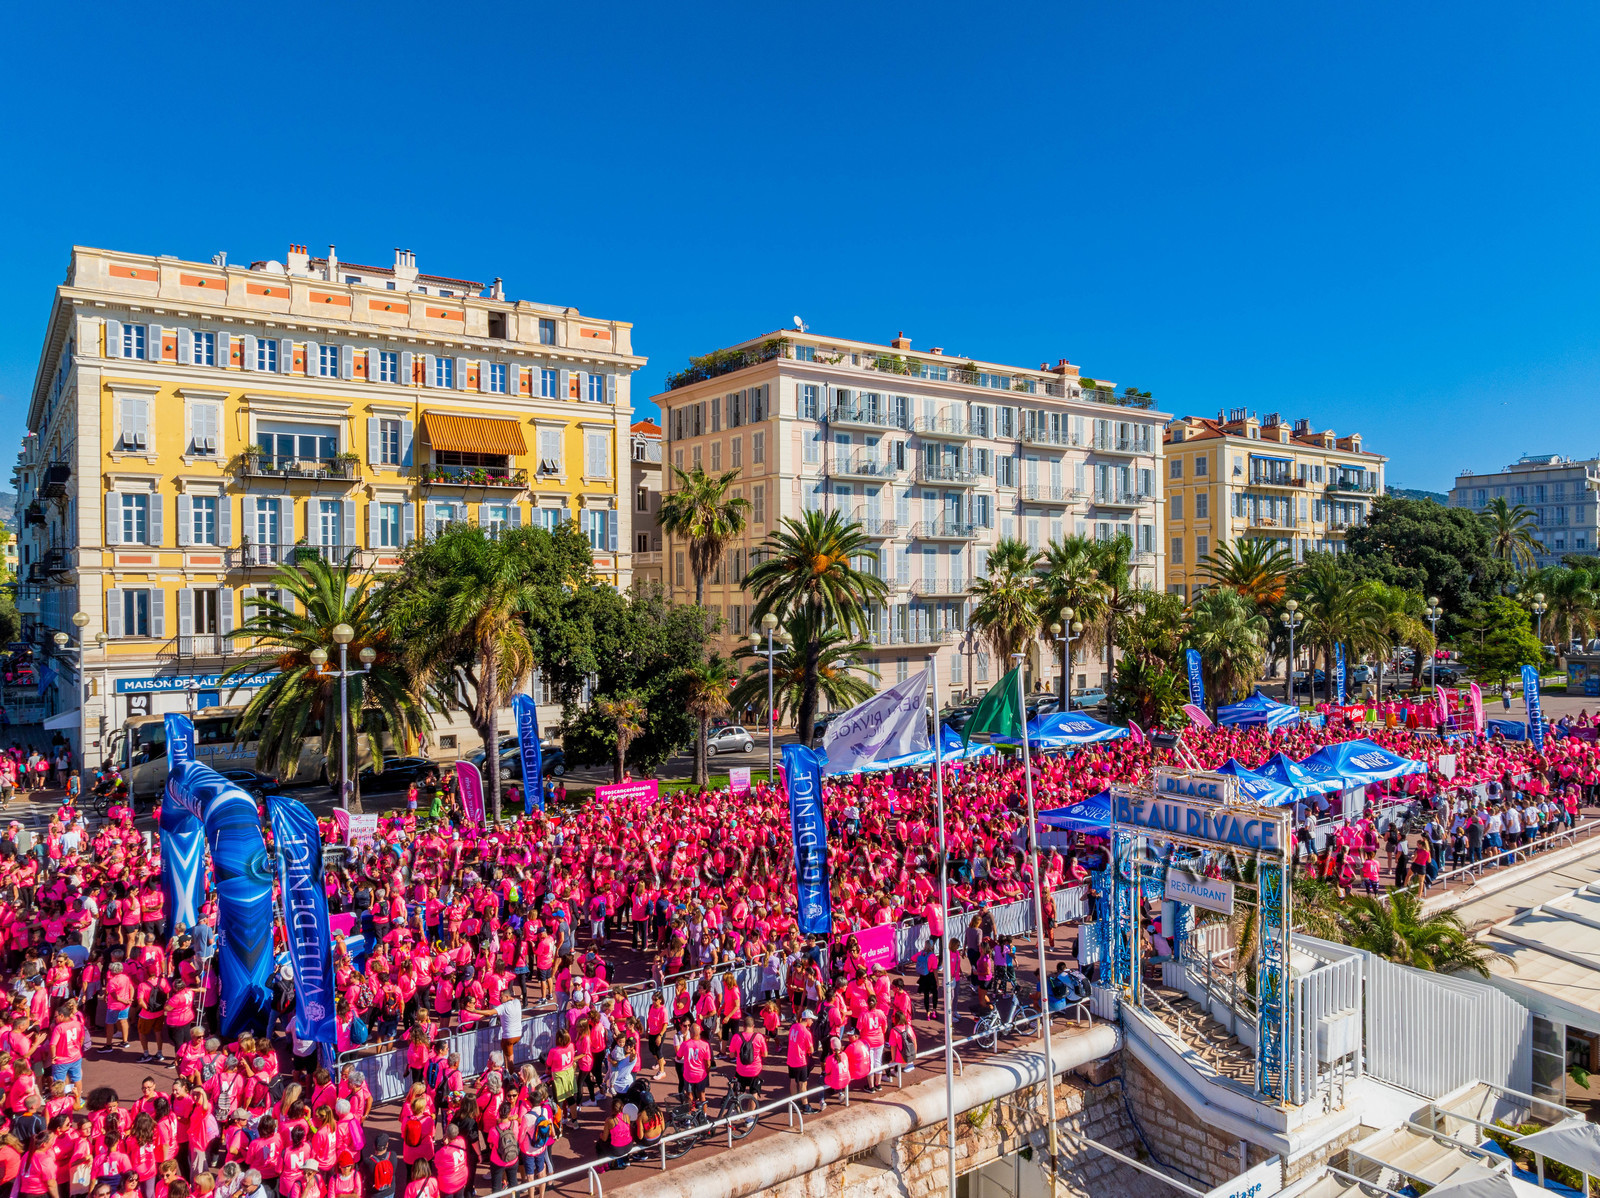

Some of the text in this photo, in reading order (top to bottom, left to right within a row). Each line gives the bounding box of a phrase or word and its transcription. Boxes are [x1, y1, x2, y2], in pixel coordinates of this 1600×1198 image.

[125, 678, 172, 690] MAISON
[1527, 678, 1539, 703] NICE
[520, 710, 538, 792] VILLE DE NICE
[1365, 756, 1394, 768] NICE
[601, 785, 651, 796] #soscancerdusein
[1081, 810, 1108, 820] NICE
[1117, 796, 1275, 847] BEAU RIVAGE
[794, 770, 822, 899] VILLE DE NICE
[1170, 880, 1227, 902] RESTAURANT
[282, 833, 325, 997] VILLE DE NICE
[868, 948, 876, 958] du
[877, 945, 890, 955] sein
